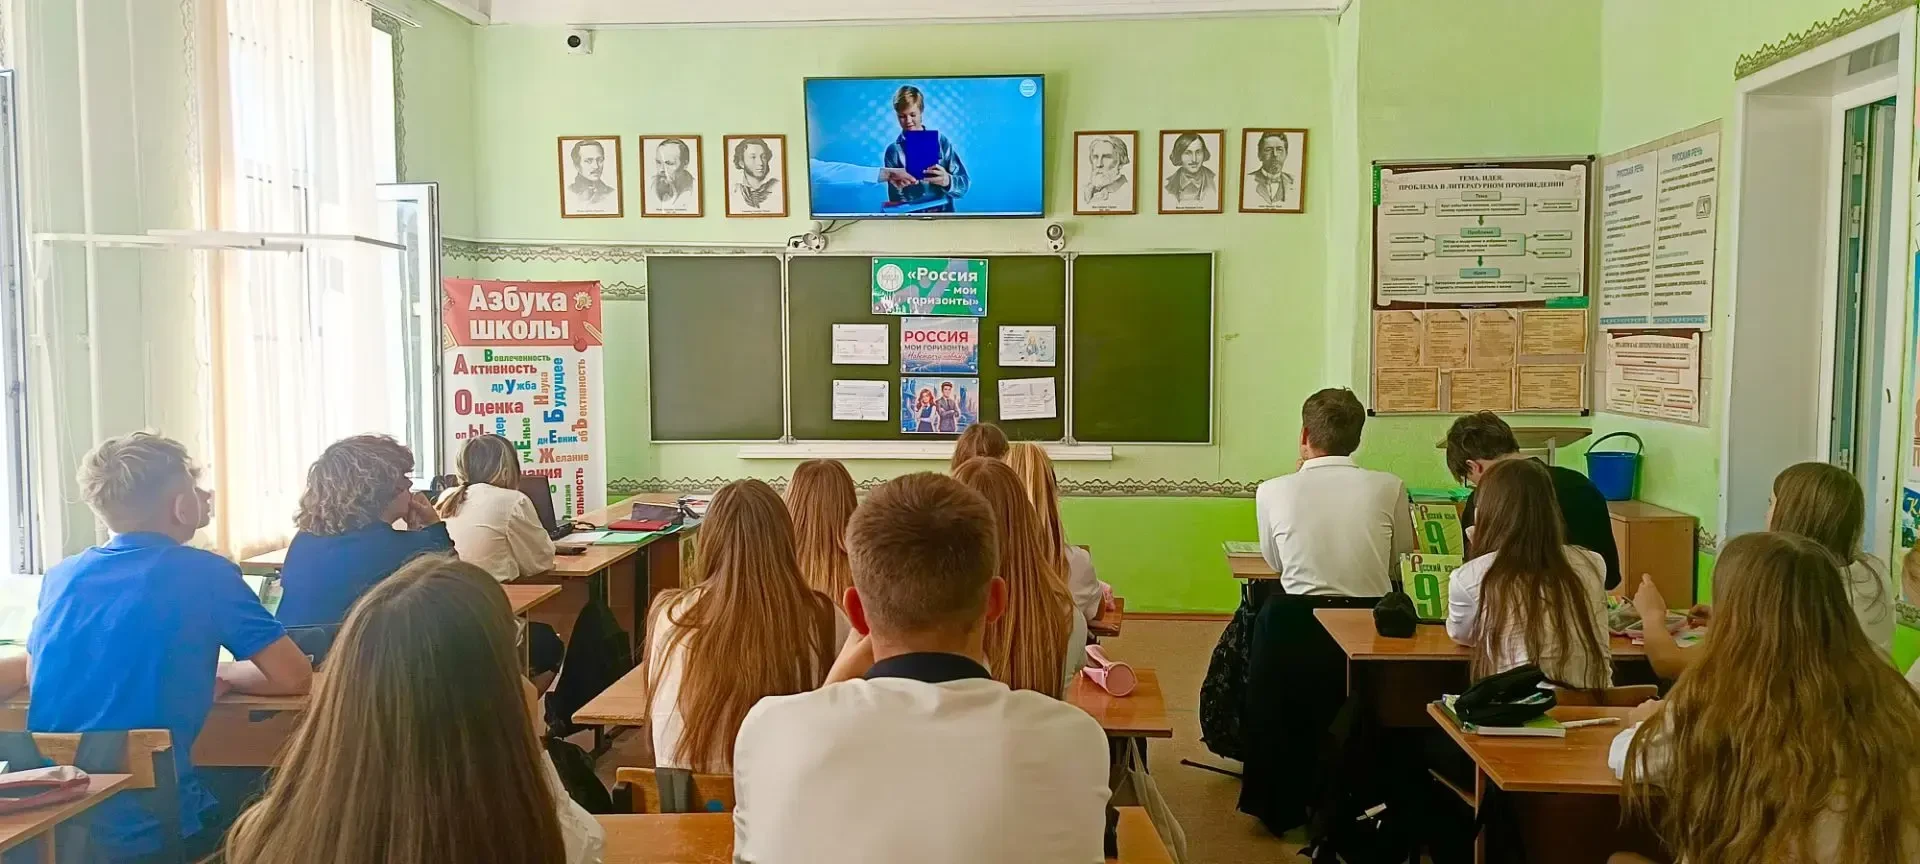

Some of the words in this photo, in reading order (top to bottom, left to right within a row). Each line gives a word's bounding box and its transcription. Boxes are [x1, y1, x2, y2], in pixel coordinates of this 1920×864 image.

[1398, 183, 1439, 191] ПРОБЛЕМА
[1446, 182, 1505, 190] ЛИТЕРАТУРНОМ
[1505, 181, 1564, 189] ПРОИЗВЕДЕНИИ
[907, 267, 978, 282] «Россия
[468, 284, 568, 317] Азбука
[953, 287, 977, 295] мои
[906, 296, 979, 307] горизонты»
[469, 319, 570, 340] школы
[904, 331, 969, 342] РОССИЯ
[453, 353, 538, 375] Активность
[484, 349, 551, 362] Вовлеченность
[533, 371, 549, 405] Наука
[543, 357, 567, 423] Будущее
[454, 389, 524, 417] Оценка
[539, 447, 589, 464] Желание
[1424, 521, 1449, 554] 9
[1410, 554, 1442, 573] Русский
[1413, 573, 1443, 619] 9
